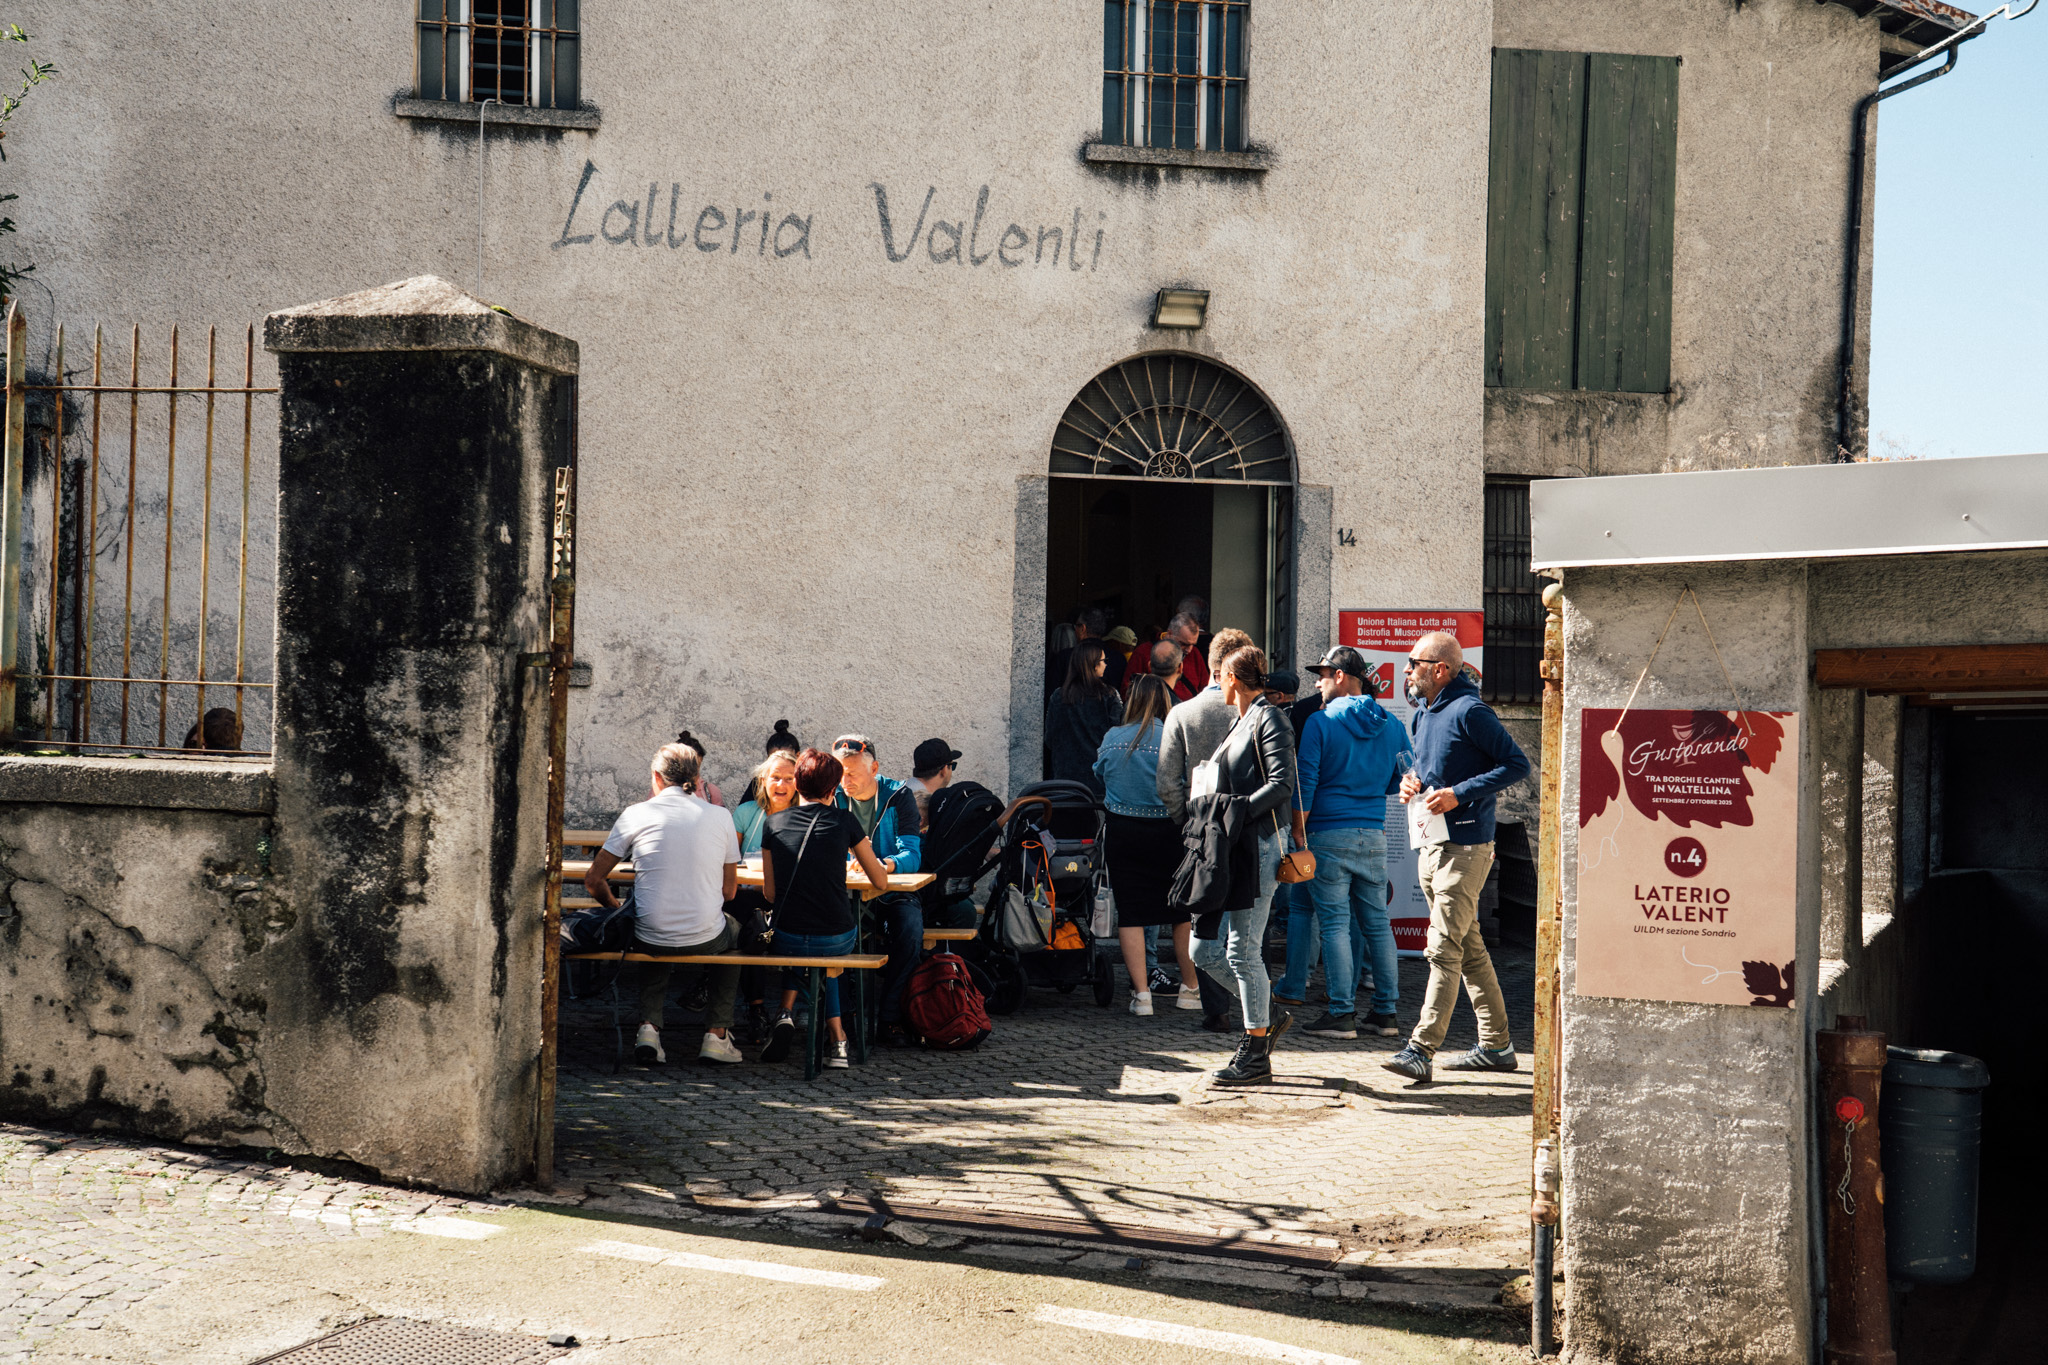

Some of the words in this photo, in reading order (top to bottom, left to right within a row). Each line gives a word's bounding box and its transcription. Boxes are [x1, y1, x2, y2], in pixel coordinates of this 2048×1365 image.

[1337, 527, 1357, 546] 14
[1357, 617, 1385, 626] Unione
[1387, 617, 1417, 626] Italiana
[1419, 617, 1440, 626] Lotta
[1442, 617, 1457, 626] alla
[1357, 627, 1390, 636] Distrofia
[1384, 638, 1417, 646] Provincial
[1627, 728, 1749, 776] Gustosando
[1663, 775, 1695, 783] BORGHI
[1703, 777, 1740, 785] CANTINE
[1653, 784, 1665, 793] IN
[1667, 785, 1731, 795] VALTELLINA
[1671, 848, 1702, 867] n.4
[1634, 884, 1730, 904] LATERIO
[1641, 904, 1729, 923] VALENT
[1633, 925, 1664, 934] UILDM
[1666, 927, 1699, 936] sezione
[1701, 928, 1736, 938] Sondrio
